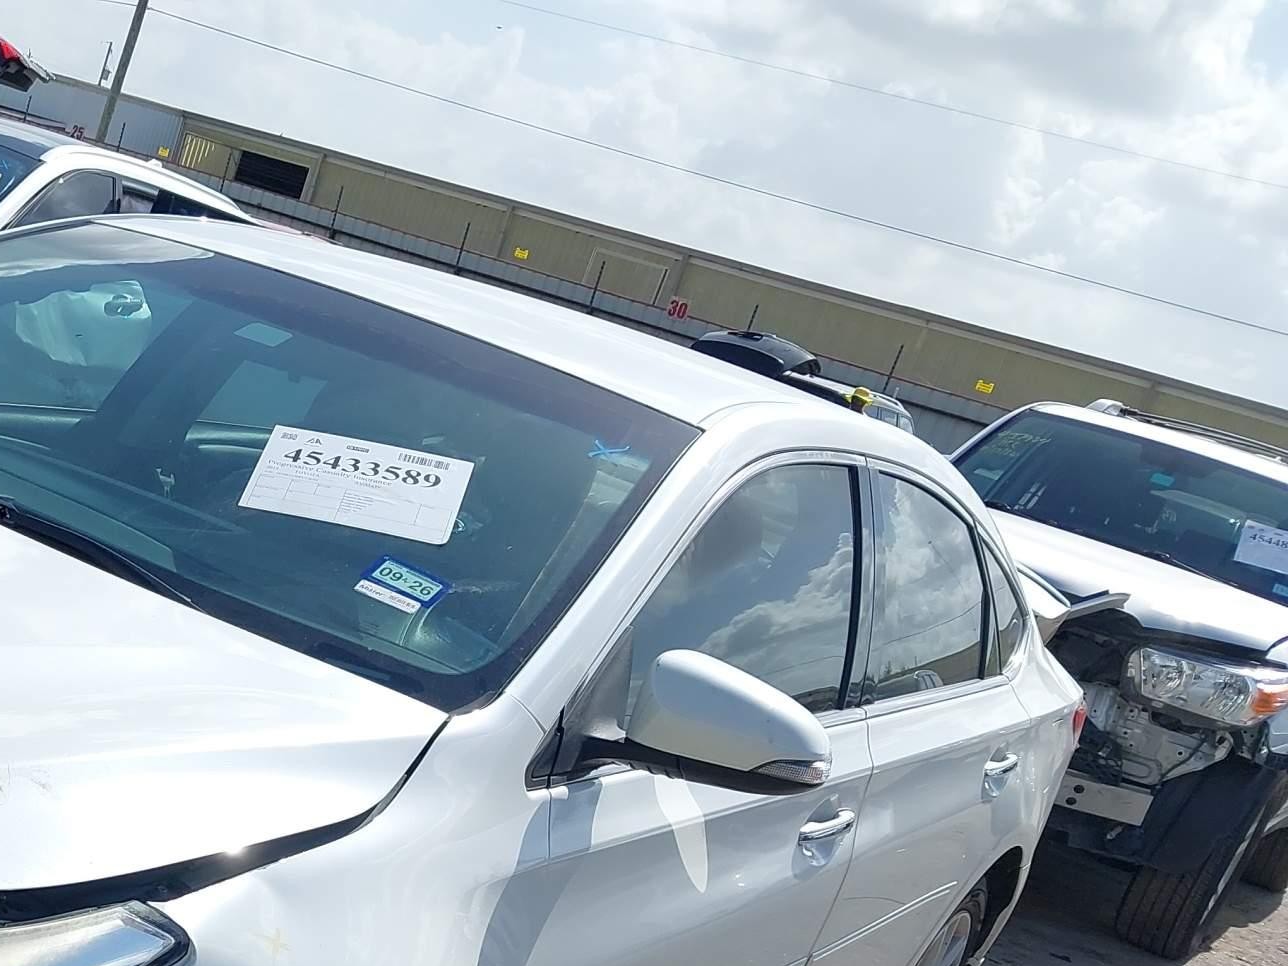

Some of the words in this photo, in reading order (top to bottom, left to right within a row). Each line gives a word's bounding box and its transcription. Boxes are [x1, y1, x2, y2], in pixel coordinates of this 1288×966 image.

[71, 124, 85, 140] 25
[668, 300, 688, 319] 30
[268, 459, 314, 473] Progressive
[315, 466, 352, 479] Casualty
[353, 474, 393, 487] Insurance
[283, 448, 443, 488] 45433589
